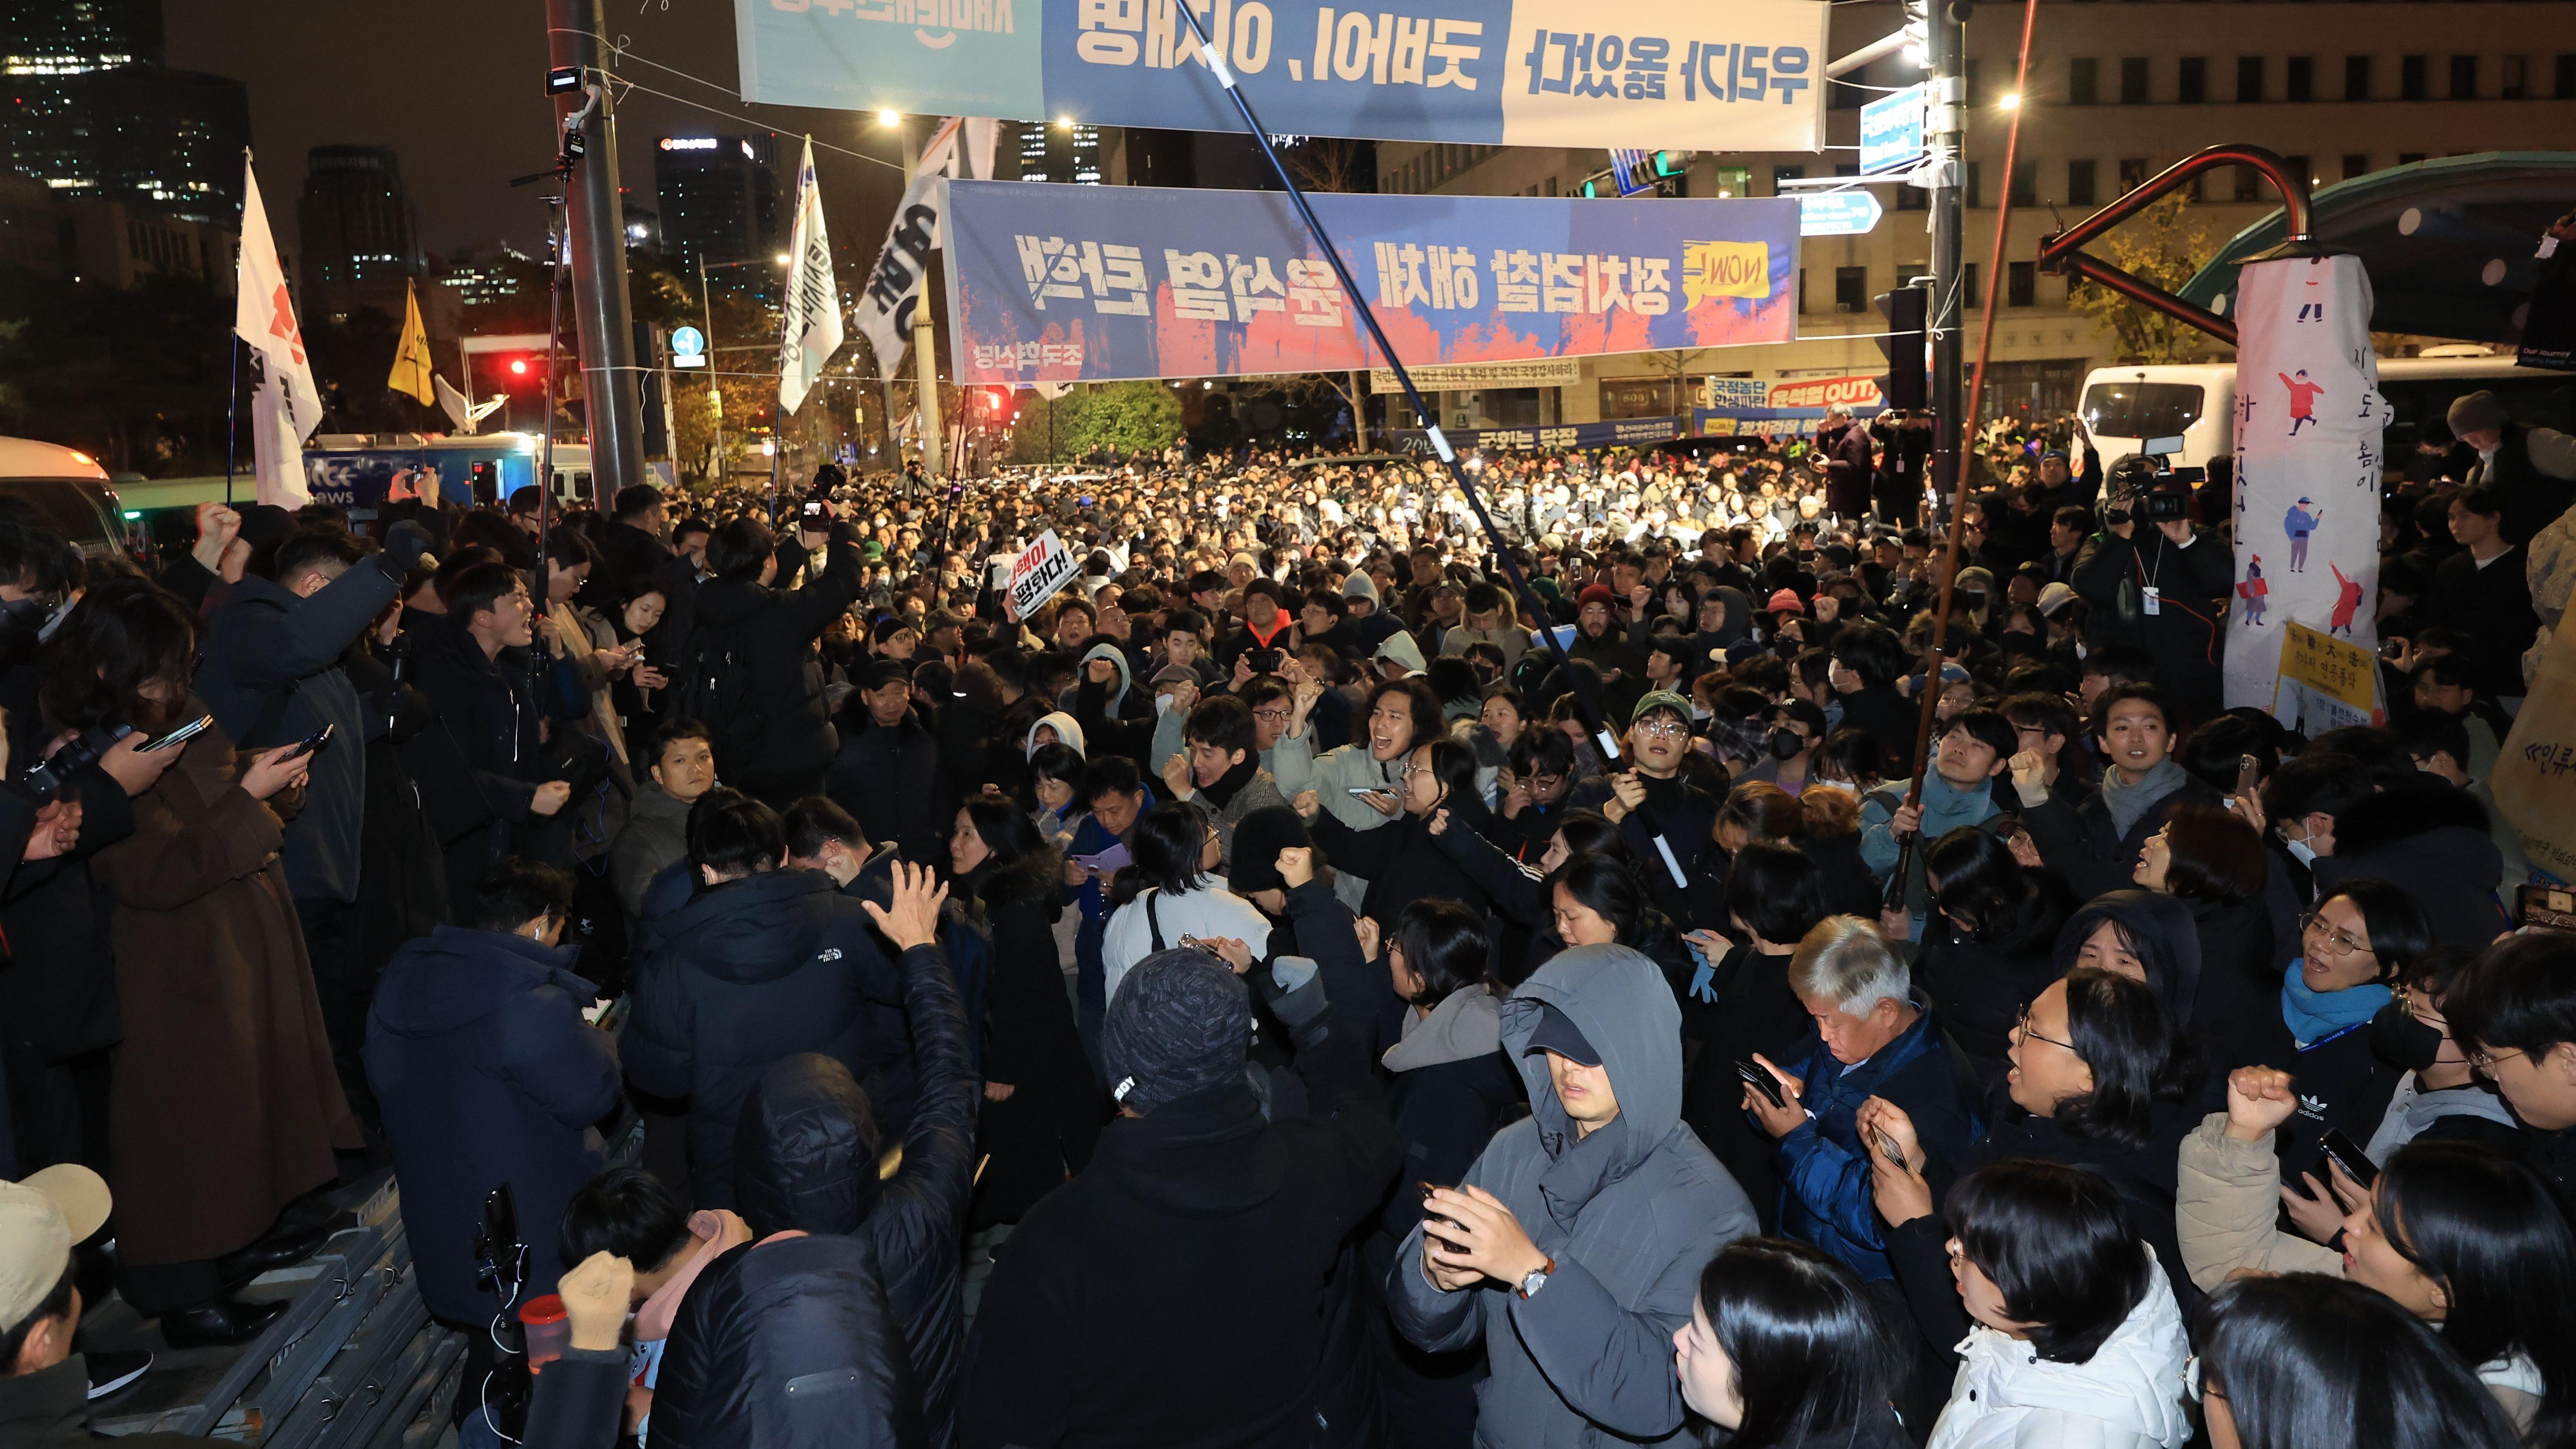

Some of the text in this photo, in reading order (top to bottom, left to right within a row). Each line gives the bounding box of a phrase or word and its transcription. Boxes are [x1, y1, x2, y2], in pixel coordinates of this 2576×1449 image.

[1714, 380, 1766, 394] 국정농단
[1825, 378, 1877, 402] OUT!
[1739, 419, 1800, 435] 정치검찰
[1478, 430, 1534, 450] 국회는
[1015, 548, 1069, 606] 평화다!
[2298, 1109, 2324, 1121] adidas
